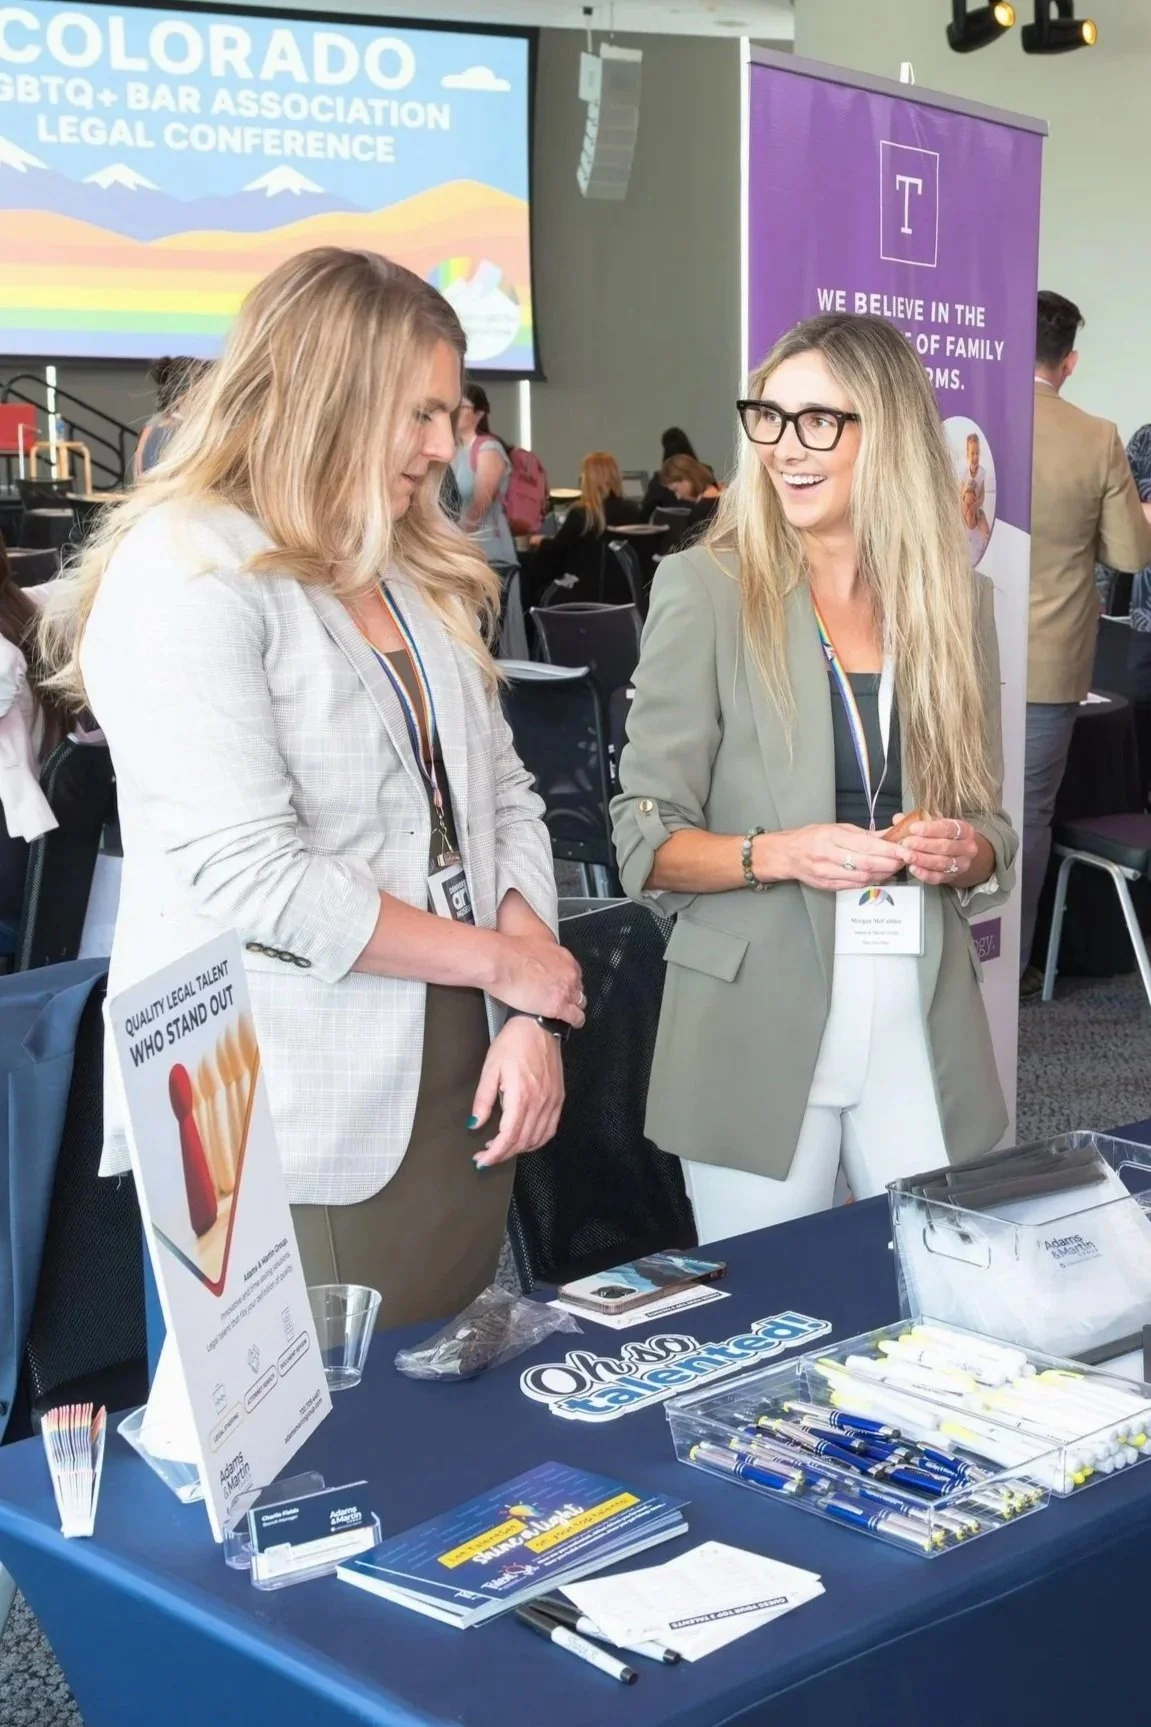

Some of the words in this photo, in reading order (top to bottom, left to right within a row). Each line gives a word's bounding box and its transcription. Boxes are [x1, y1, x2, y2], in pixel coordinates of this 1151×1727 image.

[0, 7, 415, 91] COLORADO
[127, 82, 201, 114] BAR
[211, 88, 450, 130] ASSOCIATION
[38, 114, 155, 148] LEGAL
[164, 122, 395, 163] CONFERENCE
[895, 174, 923, 234] T
[817, 287, 846, 312] WE
[854, 291, 924, 321] BELIEVE
[931, 302, 949, 324] IN
[955, 304, 985, 327] THE
[916, 333, 940, 355] OF
[946, 336, 1004, 361] FAMILY
[125, 997, 165, 1038] QUALITY
[166, 981, 196, 1010] LEGAL
[195, 960, 229, 991] TALENT
[129, 1030, 164, 1068] WHO
[166, 1002, 208, 1045] STAND
[210, 984, 234, 1016] OUT
[1044, 1234, 1083, 1251] Adams
[530, 1352, 632, 1396] Oh
[632, 1335, 693, 1364] so
[562, 1314, 826, 1415] talented!
[220, 1451, 244, 1483] Adams
[329, 1505, 358, 1519] Adams
[472, 1536, 524, 1565] shine
[529, 1503, 584, 1530] light
[672, 1614, 711, 1629] TALENTS
